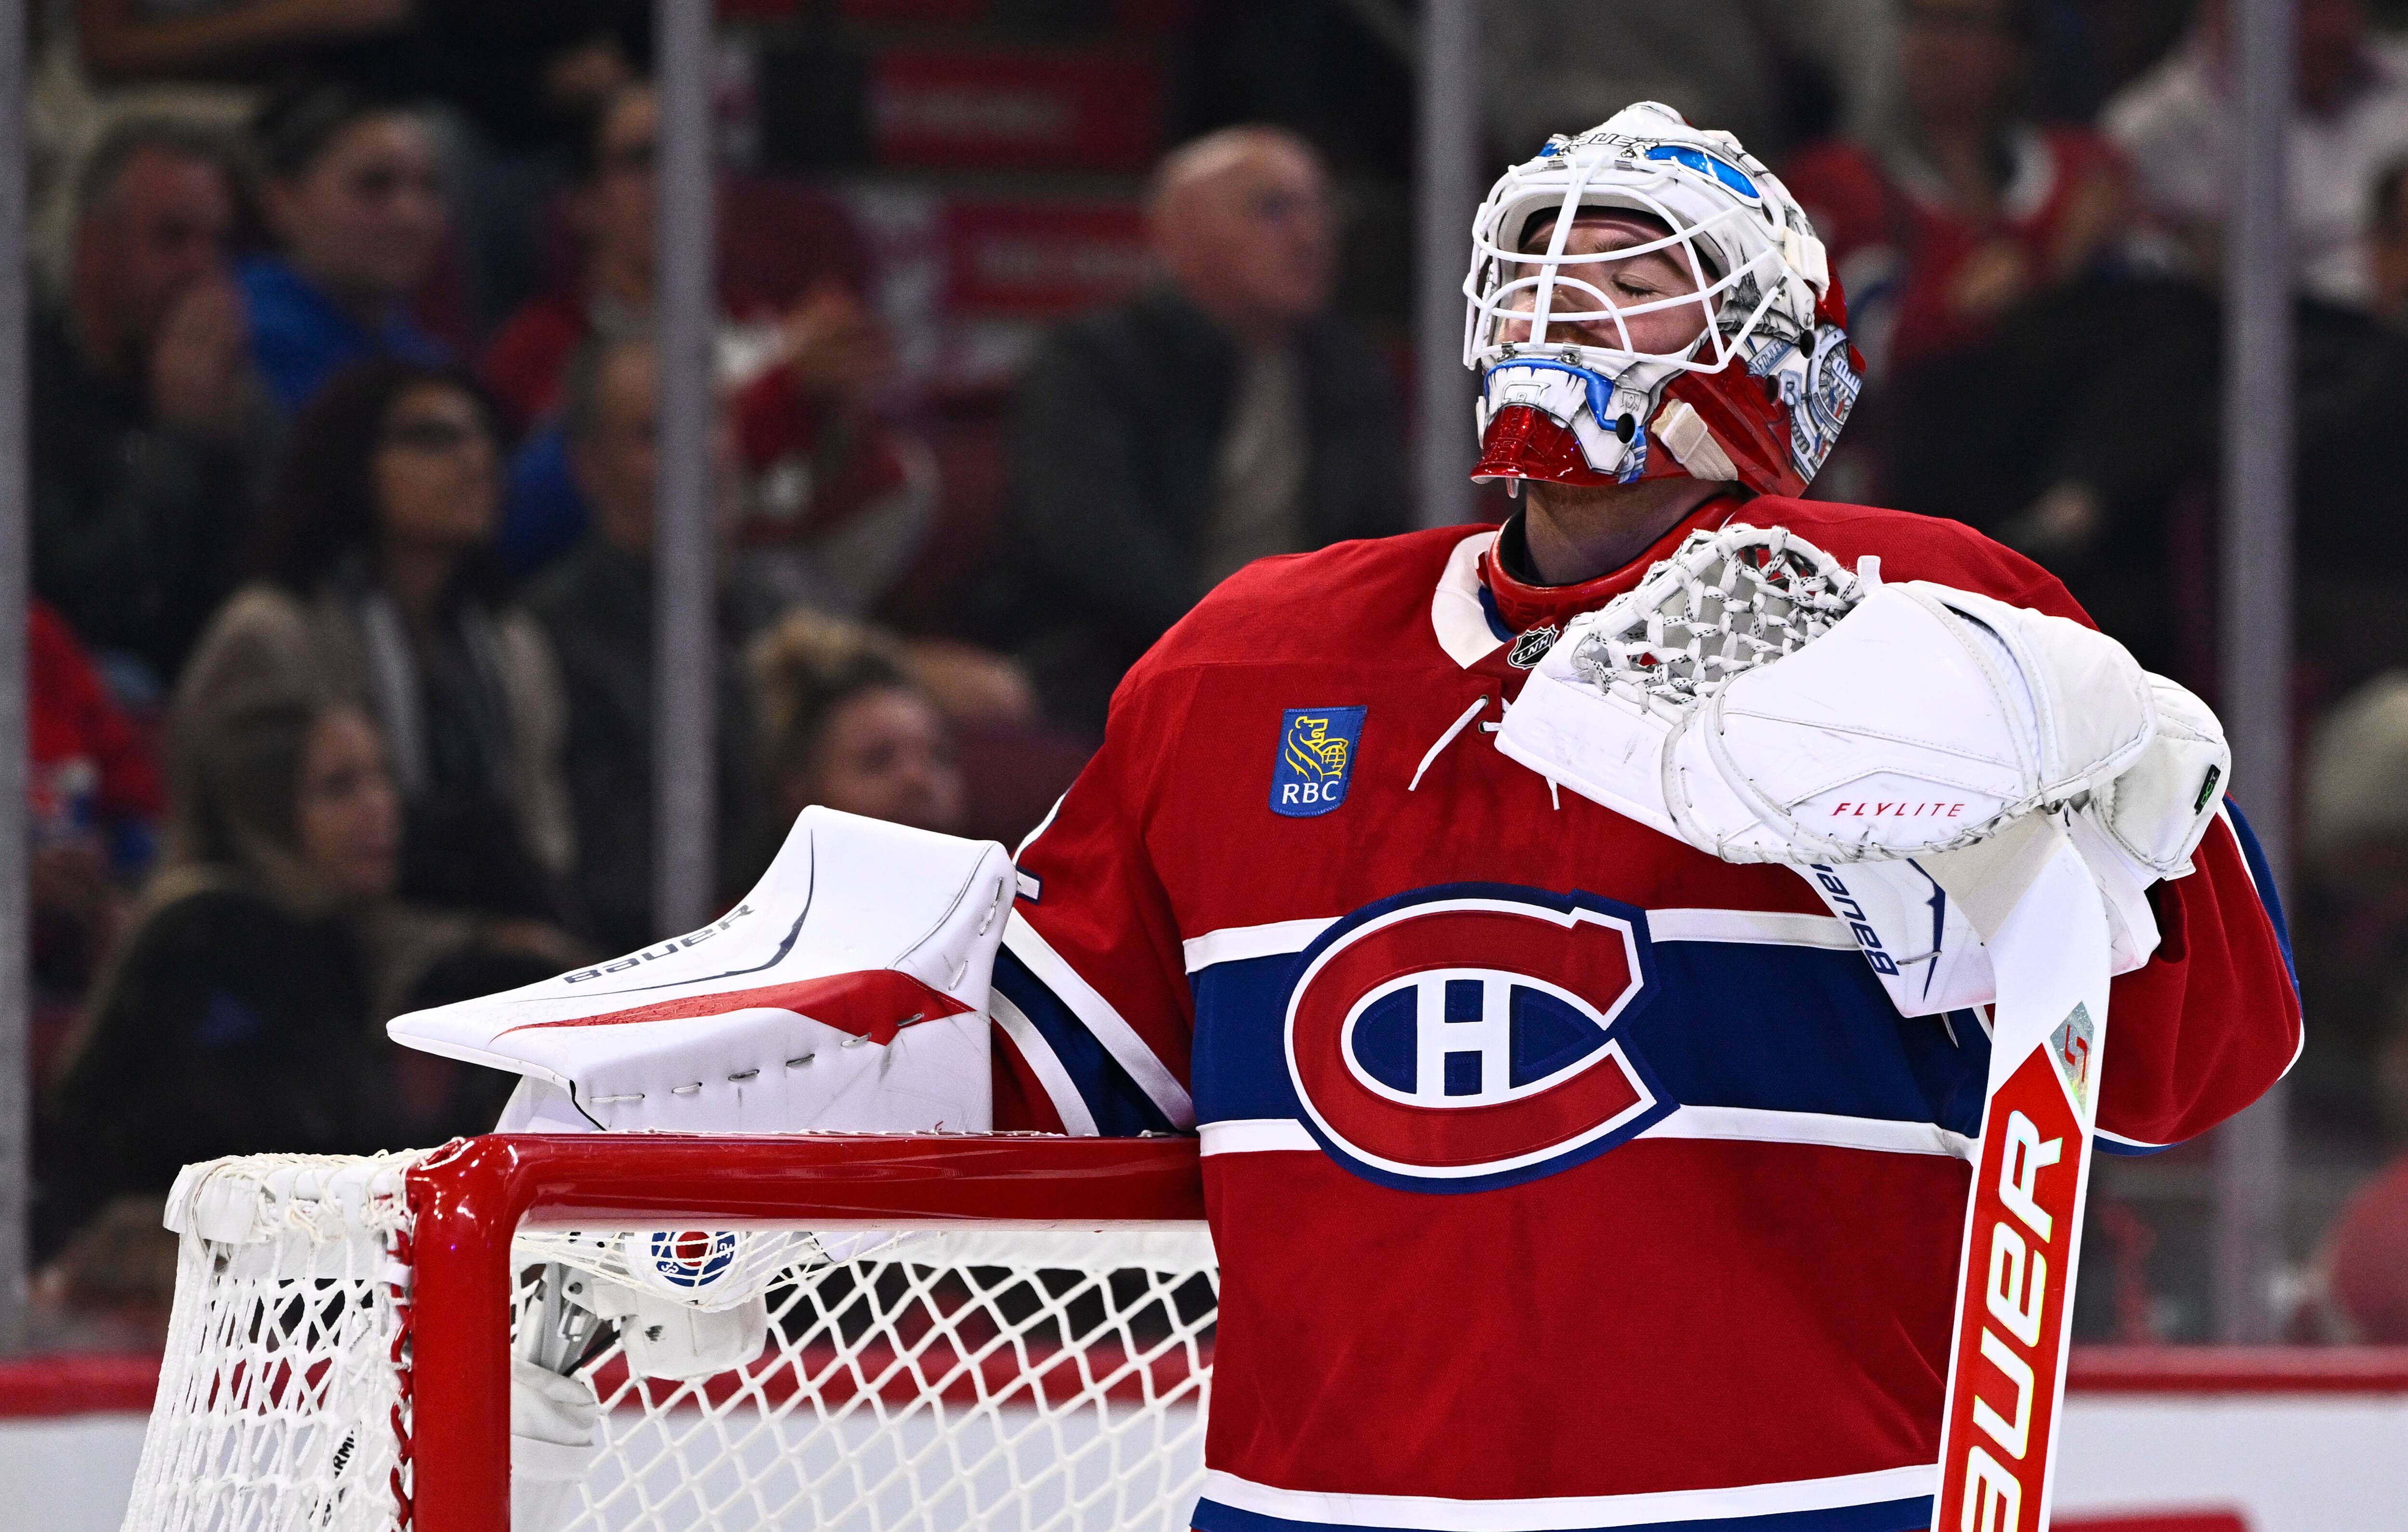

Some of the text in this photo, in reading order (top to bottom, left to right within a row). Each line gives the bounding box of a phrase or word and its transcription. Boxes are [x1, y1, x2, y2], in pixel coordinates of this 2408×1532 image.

[1517, 634, 1551, 661] LNH
[1282, 780, 1339, 805] RBC
[1830, 802, 1965, 817] FLYLITE
[563, 904, 755, 984] BAUER
